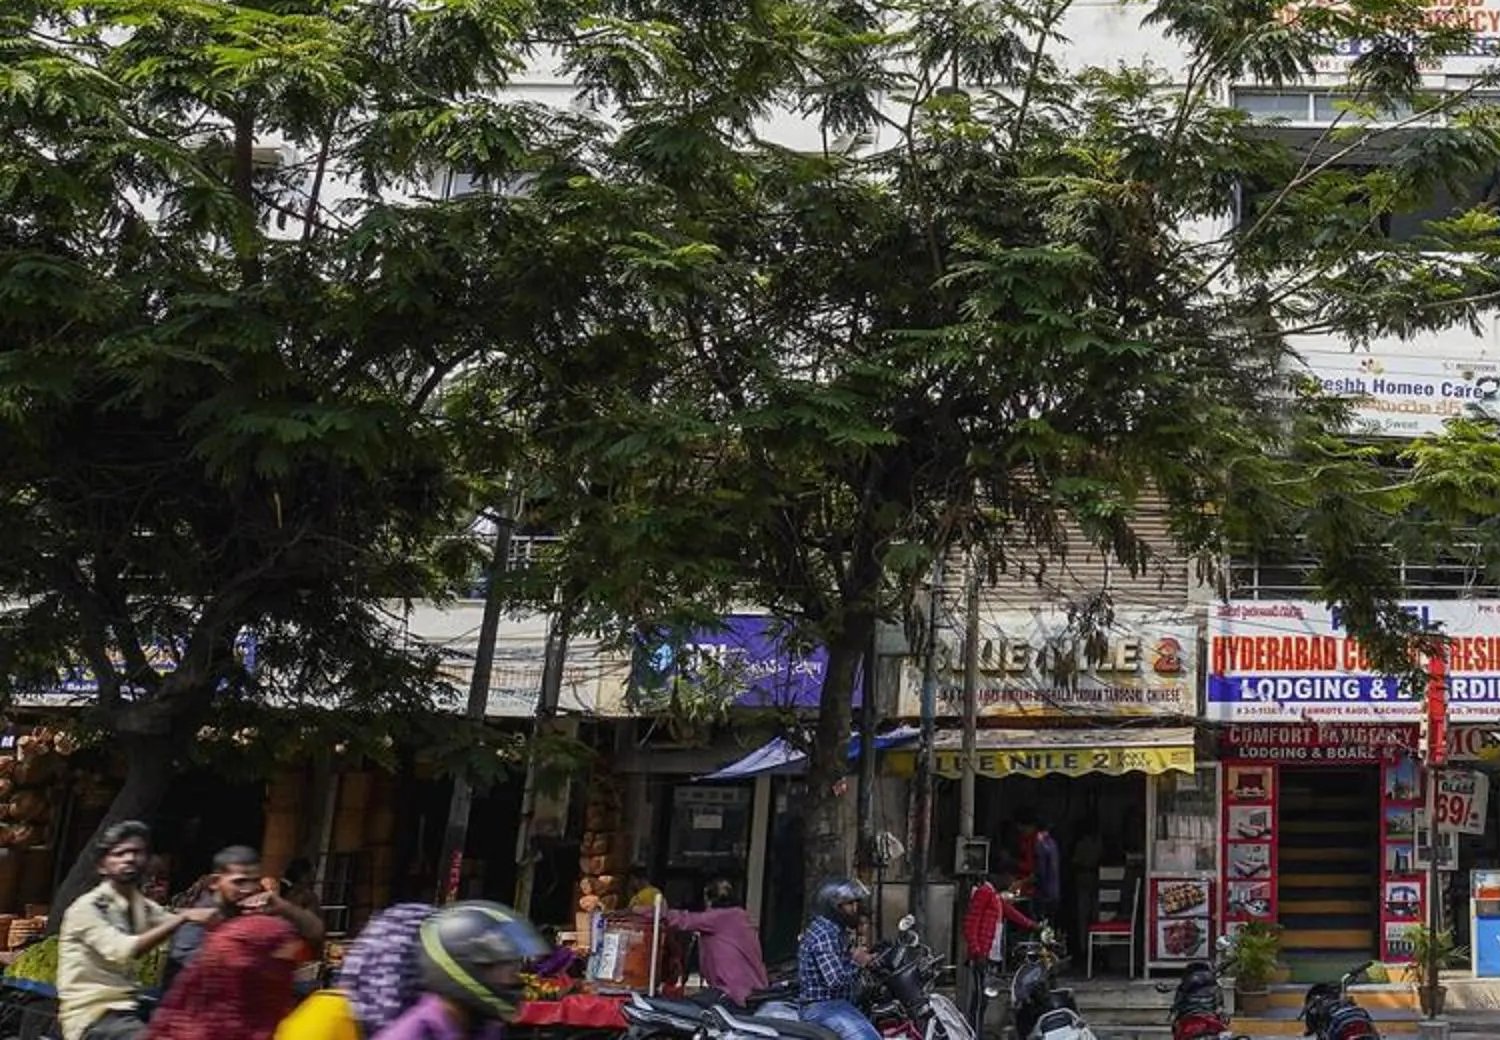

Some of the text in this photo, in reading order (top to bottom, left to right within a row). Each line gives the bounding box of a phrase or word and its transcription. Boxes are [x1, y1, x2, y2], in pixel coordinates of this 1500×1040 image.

[1373, 378, 1434, 397] Homeo
[1441, 381, 1484, 399] Care
[1153, 637, 1183, 673] 2
[1213, 636, 1336, 671] HYDERABAD
[1241, 678, 1361, 701] LODGING
[1369, 679, 1388, 700] &
[1230, 727, 1314, 744] COMFORT
[1010, 753, 1078, 771] NILE
[1091, 753, 1110, 769] 2
[1240, 747, 1308, 759] LODGING
[1311, 747, 1323, 759] &
